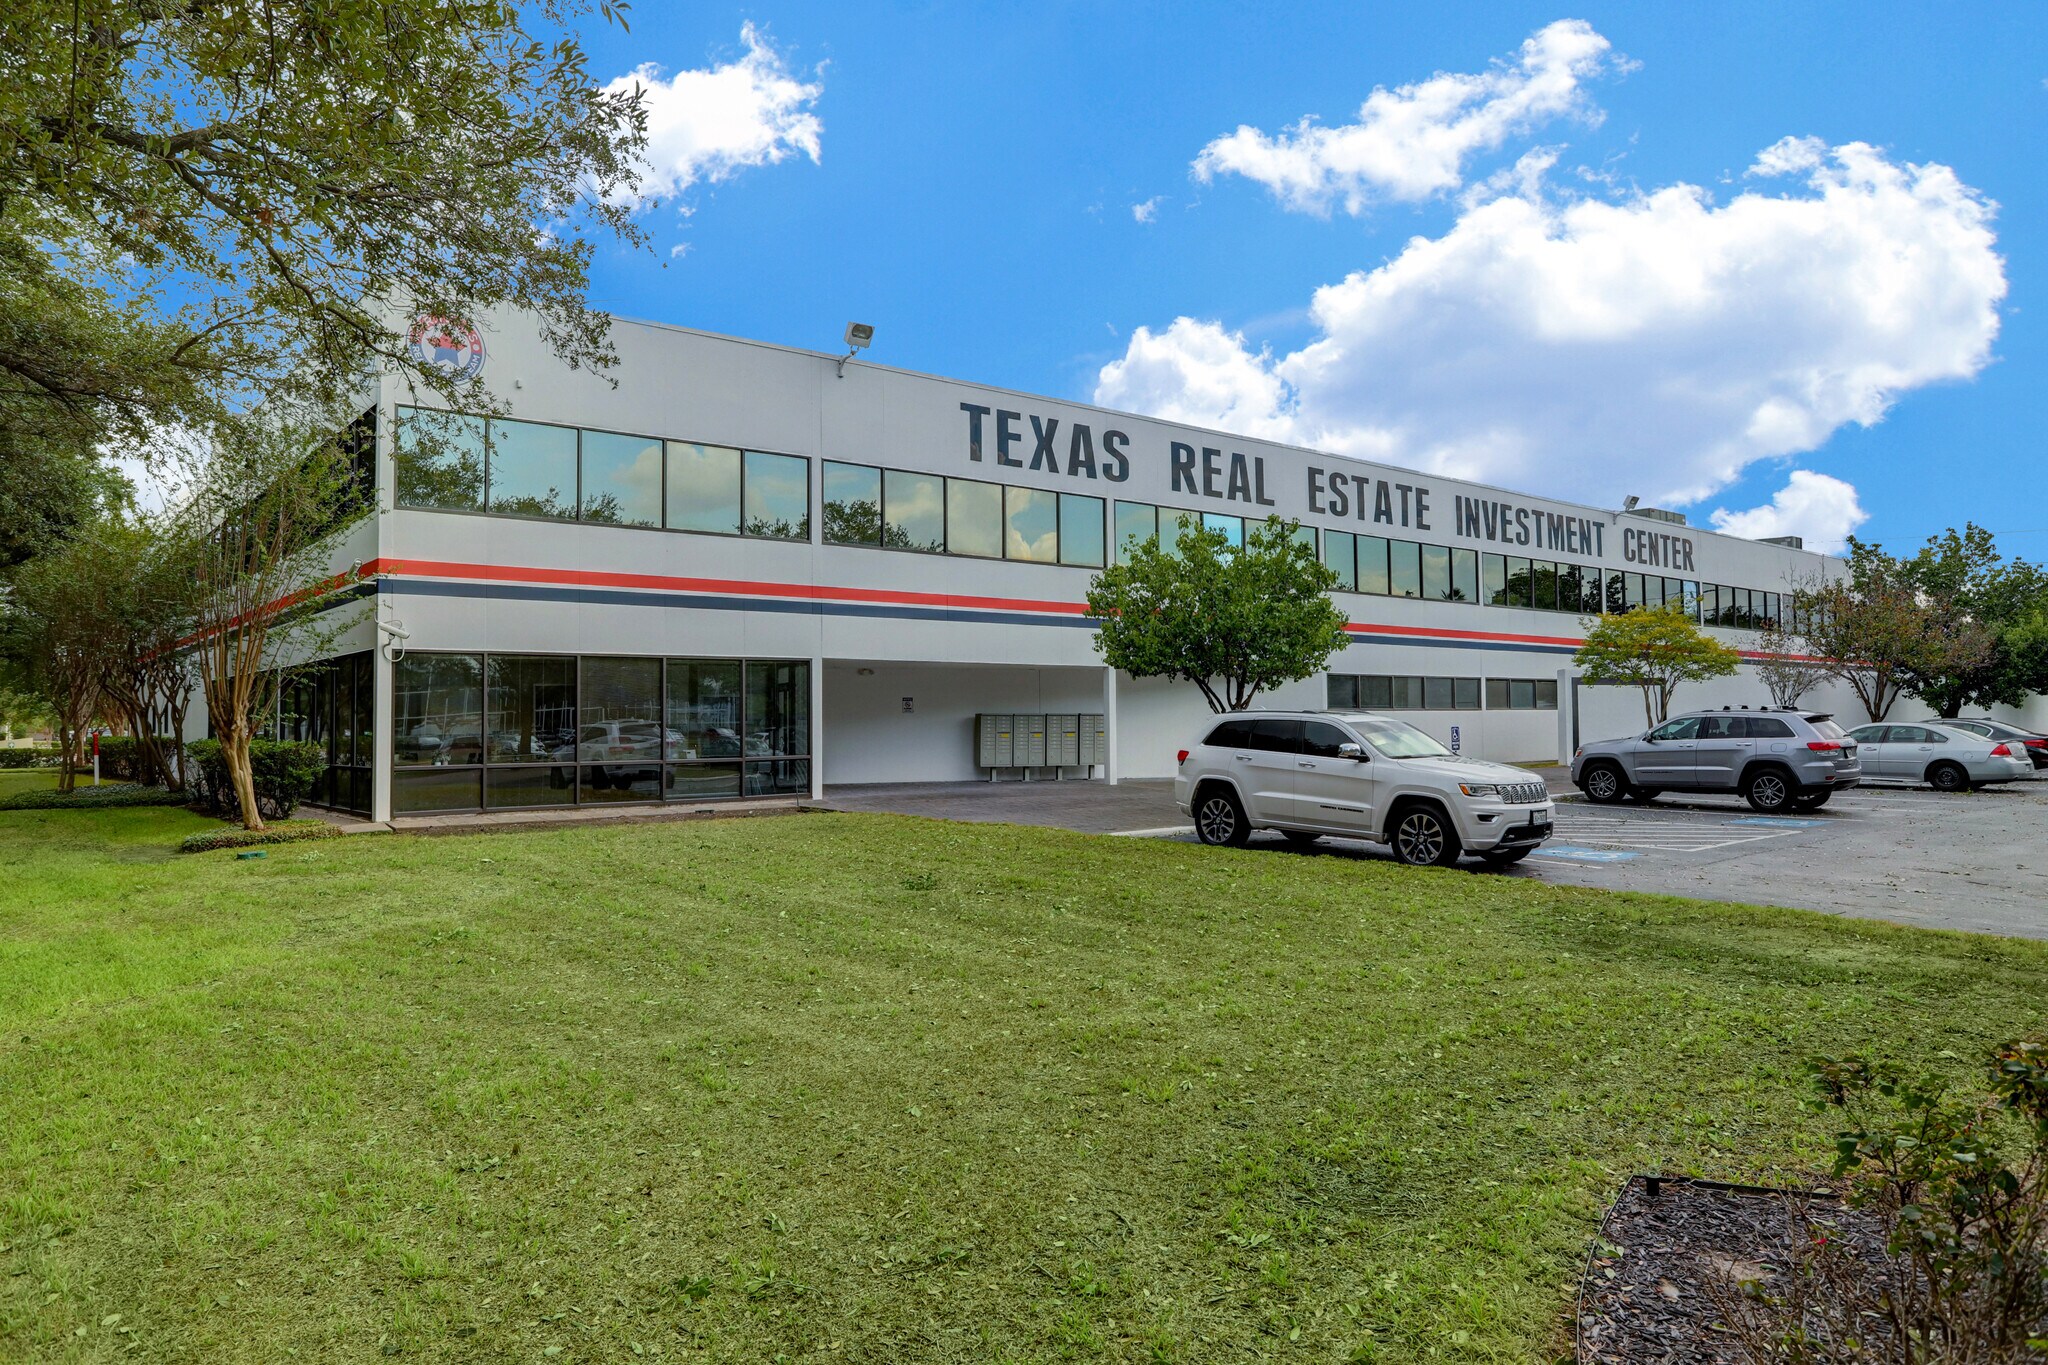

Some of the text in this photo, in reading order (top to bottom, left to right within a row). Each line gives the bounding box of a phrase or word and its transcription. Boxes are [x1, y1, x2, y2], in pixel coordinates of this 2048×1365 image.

[960, 402, 1695, 572] TEXAS REAL ESTATE INVESTMENT CENTER
